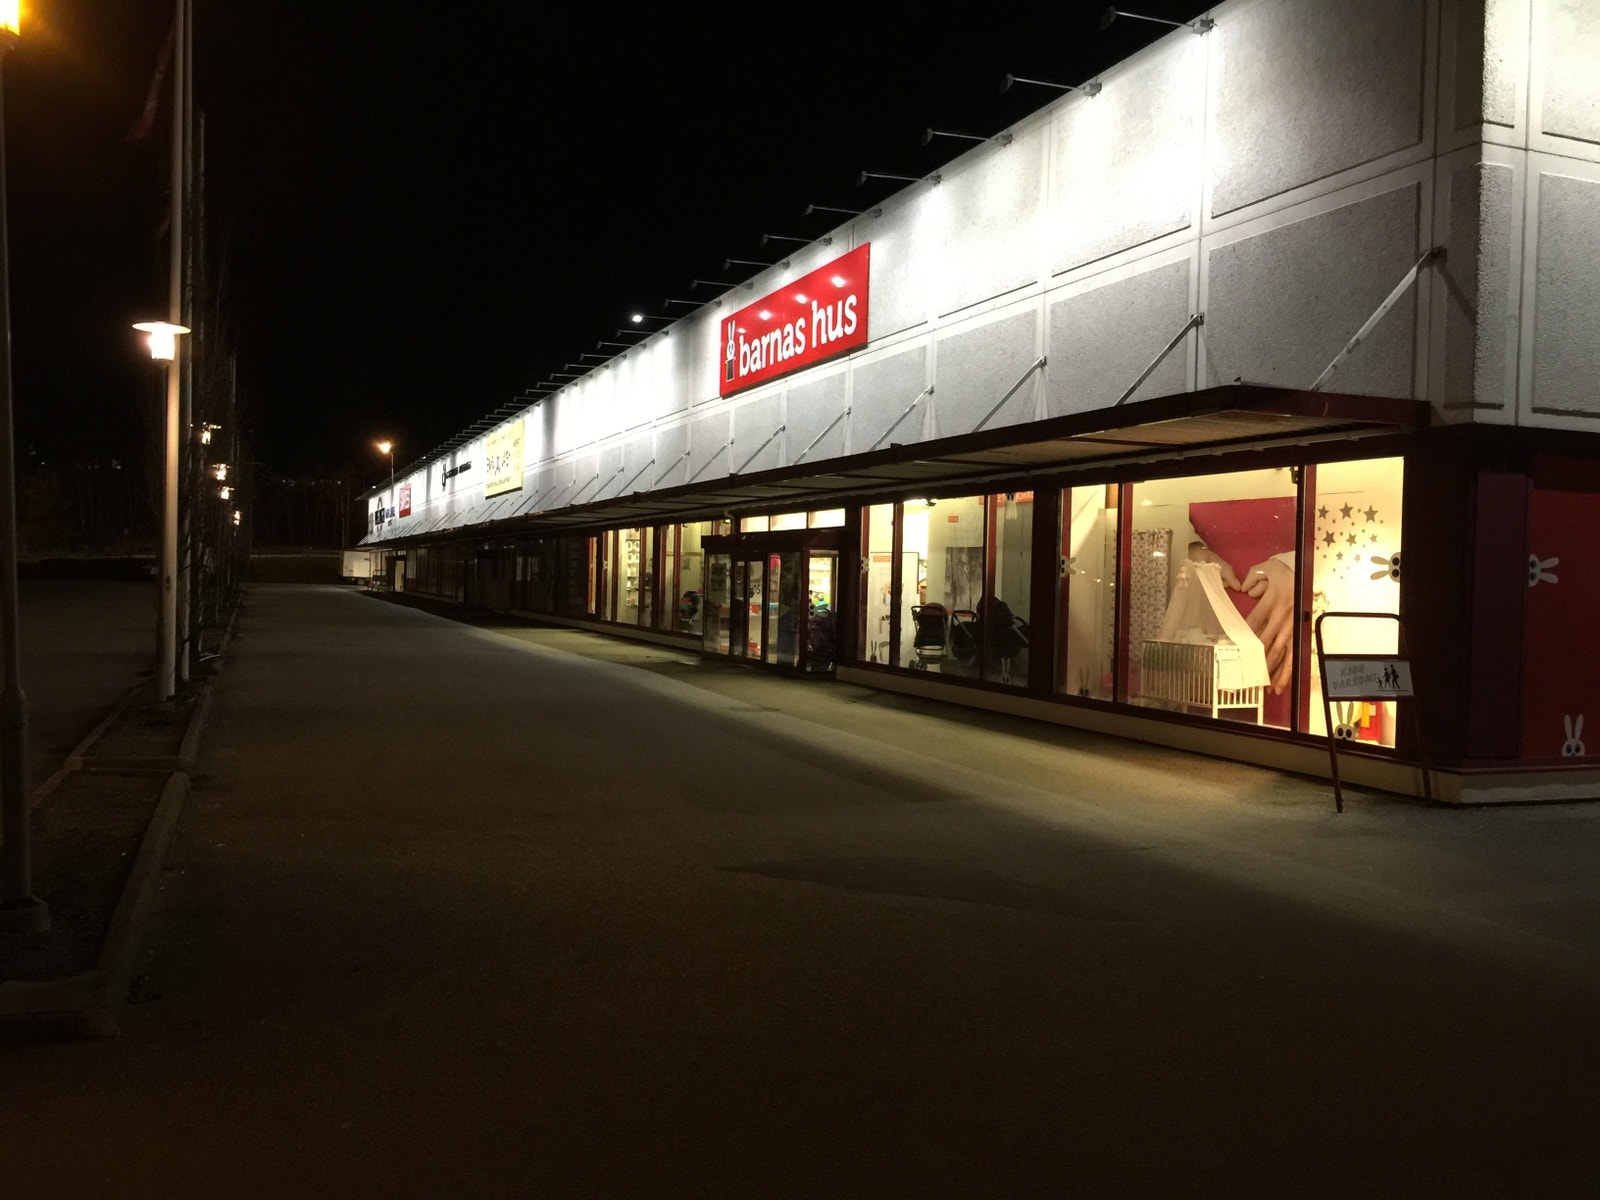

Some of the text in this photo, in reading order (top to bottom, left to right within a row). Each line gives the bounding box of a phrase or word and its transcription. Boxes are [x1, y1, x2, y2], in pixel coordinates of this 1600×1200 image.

[739, 294, 857, 377] barnas hus
[1332, 672, 1378, 690] VARSOMT
